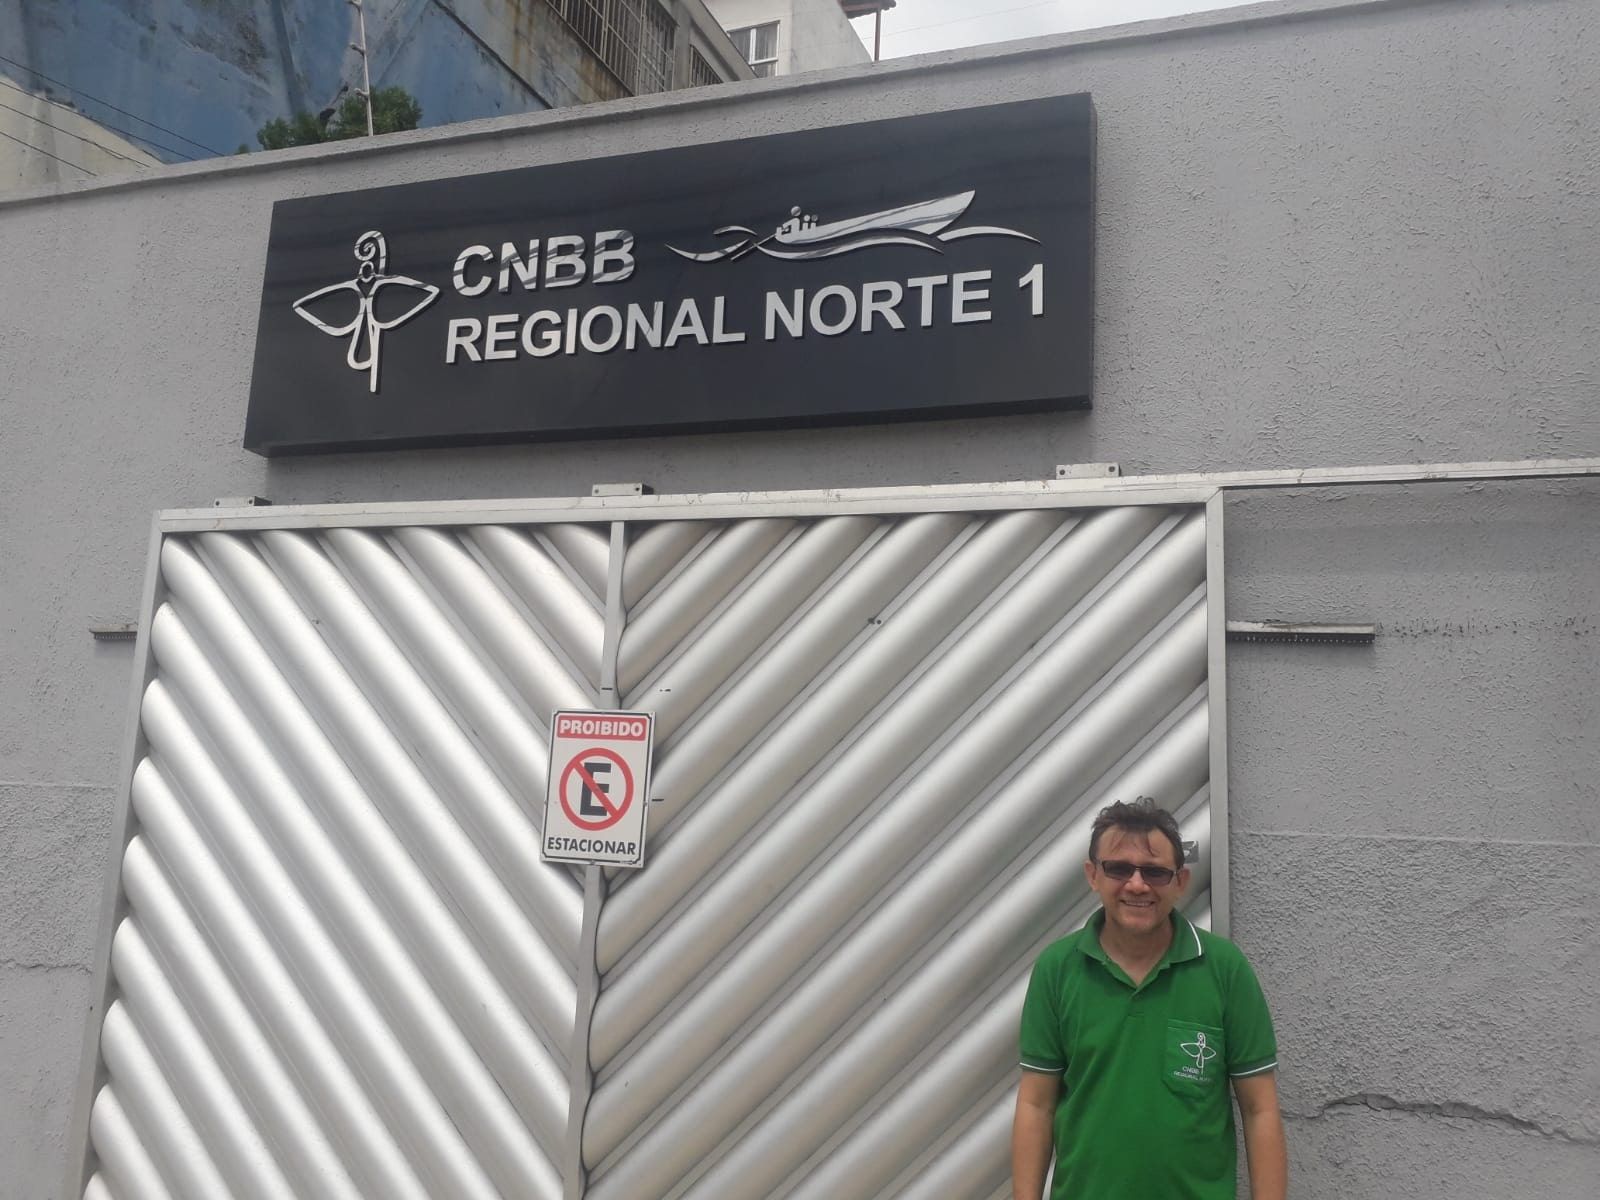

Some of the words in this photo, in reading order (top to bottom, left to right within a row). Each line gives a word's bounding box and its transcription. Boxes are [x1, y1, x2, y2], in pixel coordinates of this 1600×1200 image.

[453, 229, 635, 296] CNBB
[445, 296, 746, 363] REGIONAL
[764, 269, 992, 340] NORTE
[1018, 263, 1044, 316] 1
[560, 719, 644, 737] PROIBIDO
[580, 762, 612, 816] E
[547, 837, 636, 855] ESTACIONAR
